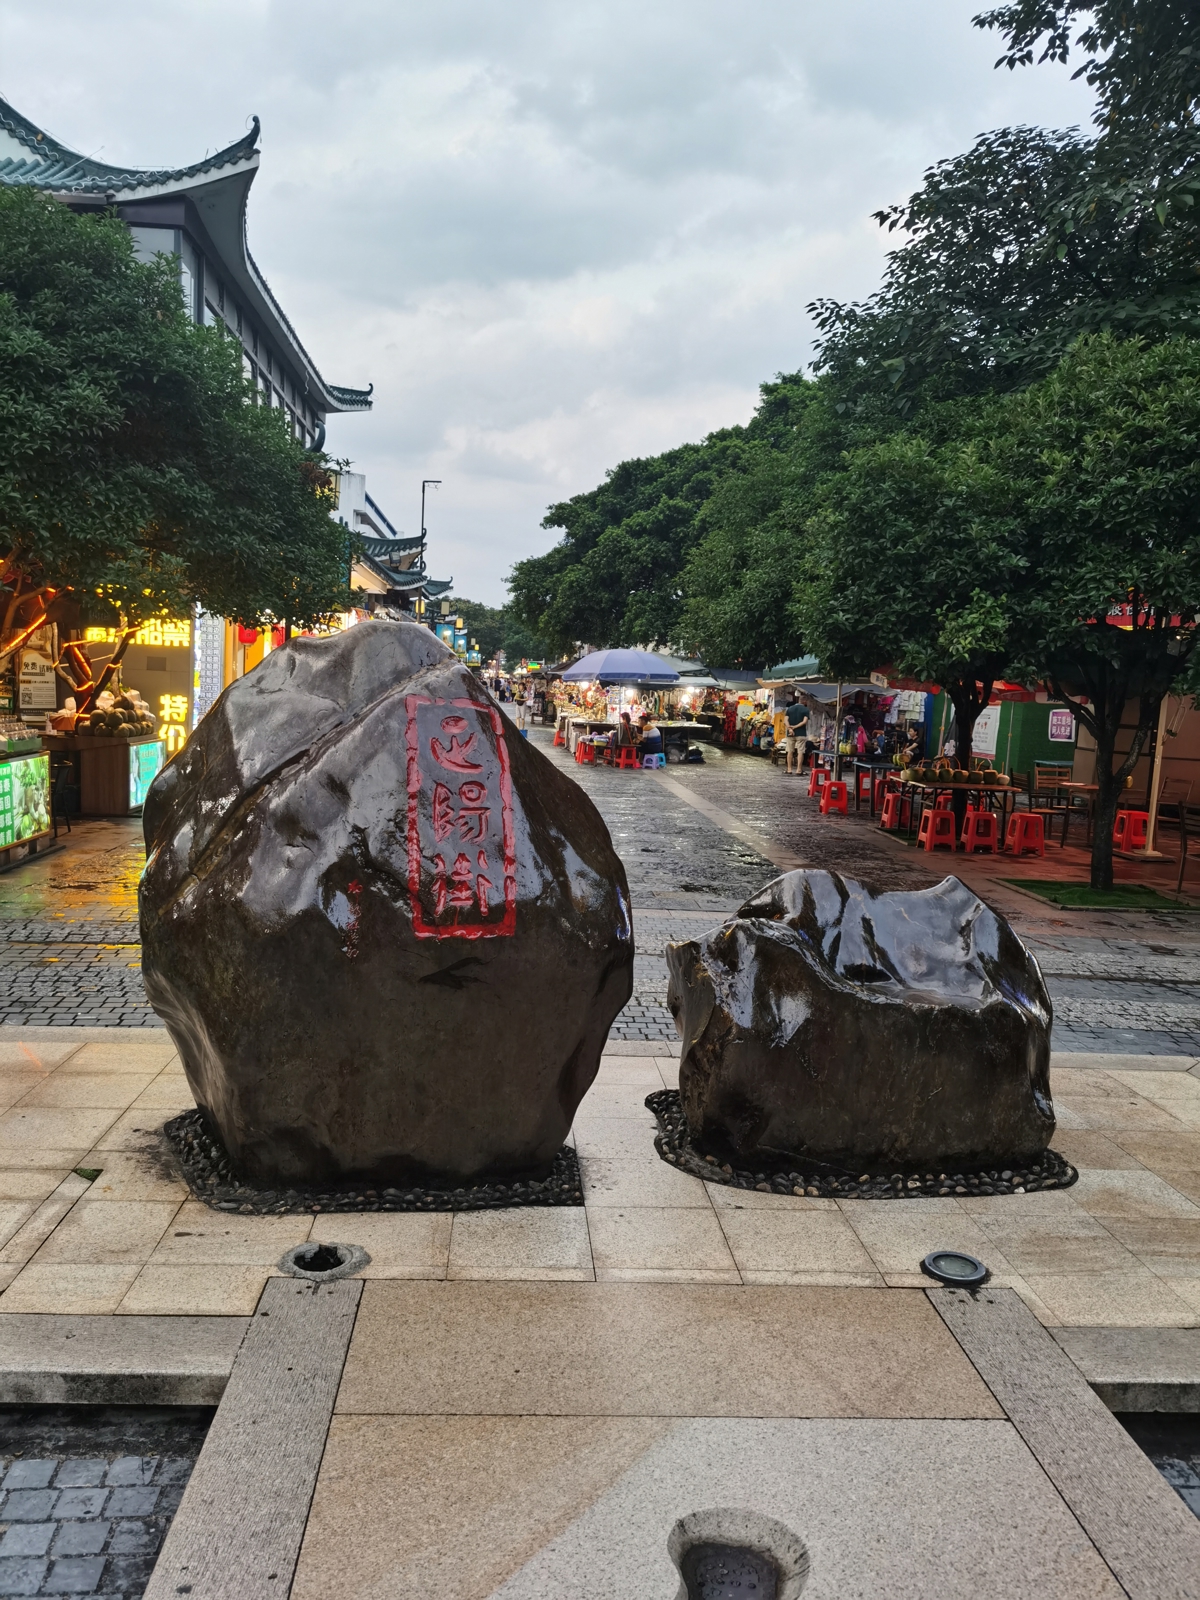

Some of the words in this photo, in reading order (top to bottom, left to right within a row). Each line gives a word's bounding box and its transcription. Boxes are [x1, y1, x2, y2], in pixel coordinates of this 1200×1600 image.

[159, 693, 188, 751] 特价
[1051, 725, 1071, 735] 闲人免进
